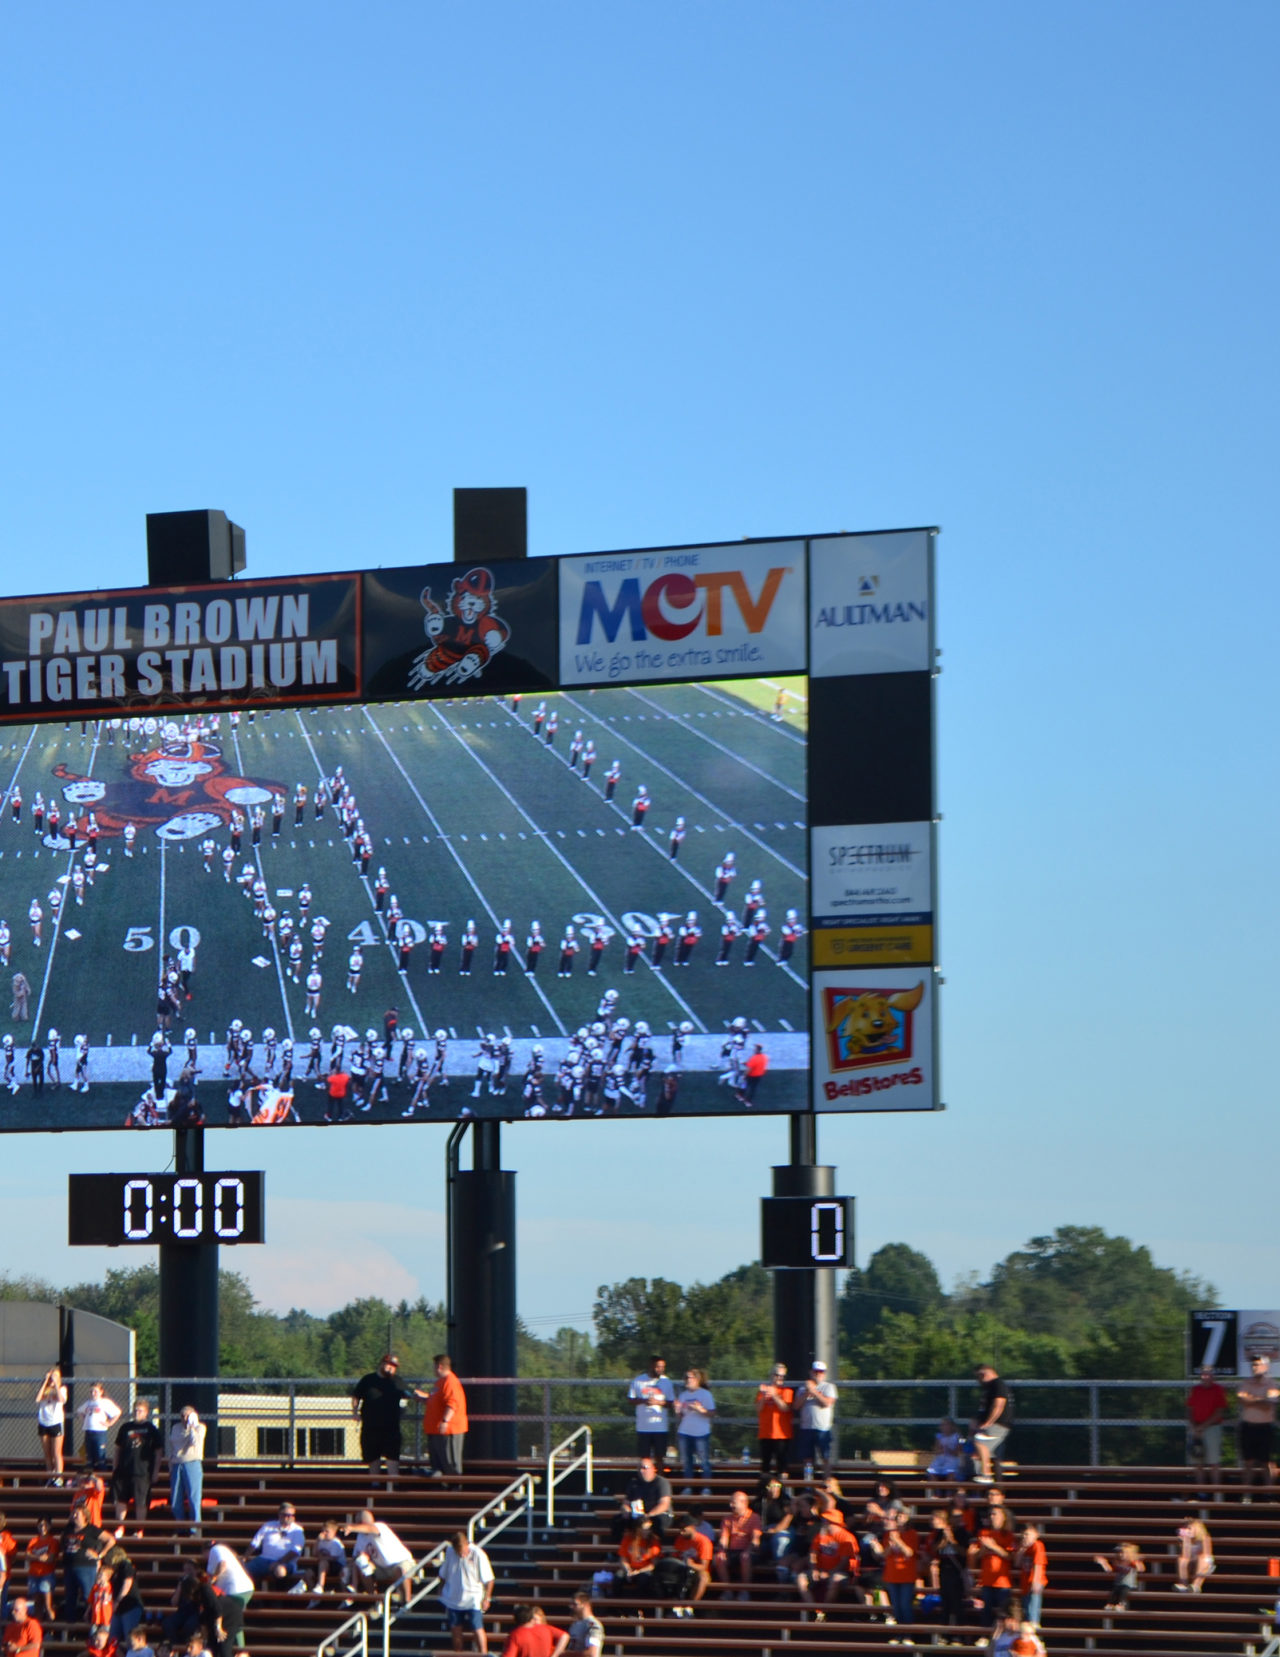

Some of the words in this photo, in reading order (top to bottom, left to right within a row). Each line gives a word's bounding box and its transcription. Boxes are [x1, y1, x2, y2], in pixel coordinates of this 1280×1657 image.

[584, 559, 633, 574] INTERNET
[642, 558, 656, 569] TV
[664, 554, 700, 568] PHONE
[28, 605, 141, 657] PAUL
[143, 593, 310, 648] BROWN
[815, 600, 926, 628] AULTMAN
[2, 655, 127, 705] TIGER
[136, 639, 338, 697] STADIUM
[575, 653, 606, 674] We
[608, 655, 631, 678] go
[634, 649, 663, 669] the
[666, 648, 712, 667] extra
[829, 843, 912, 867] SPECTRUM
[124, 1178, 245, 1238] 0:00
[811, 1203, 843, 1260] 0
[1200, 1320, 1227, 1367] 7
